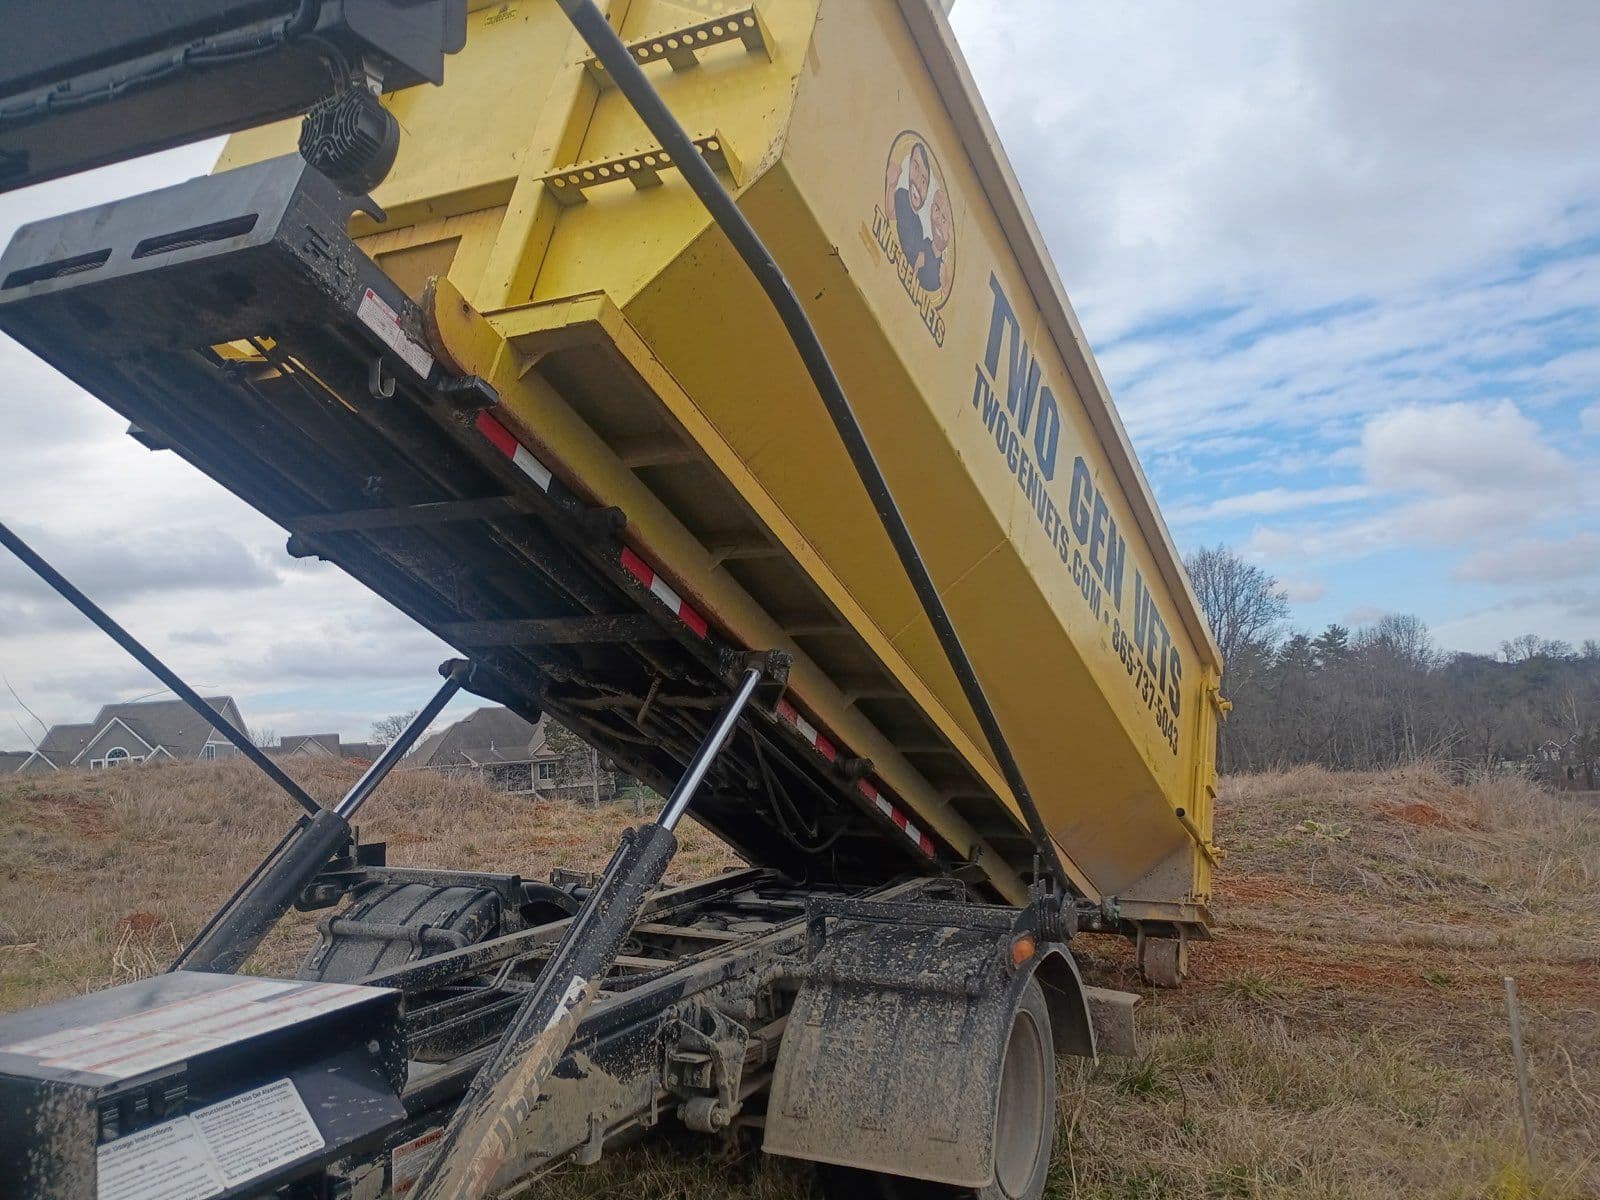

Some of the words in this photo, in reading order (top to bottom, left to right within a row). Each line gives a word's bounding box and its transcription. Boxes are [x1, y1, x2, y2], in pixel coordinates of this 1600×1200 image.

[985, 270, 1060, 481] TWO
[1069, 456, 1125, 613] GEN
[1134, 568, 1182, 718] VETS
[1112, 618, 1179, 756] 865-737-5043
